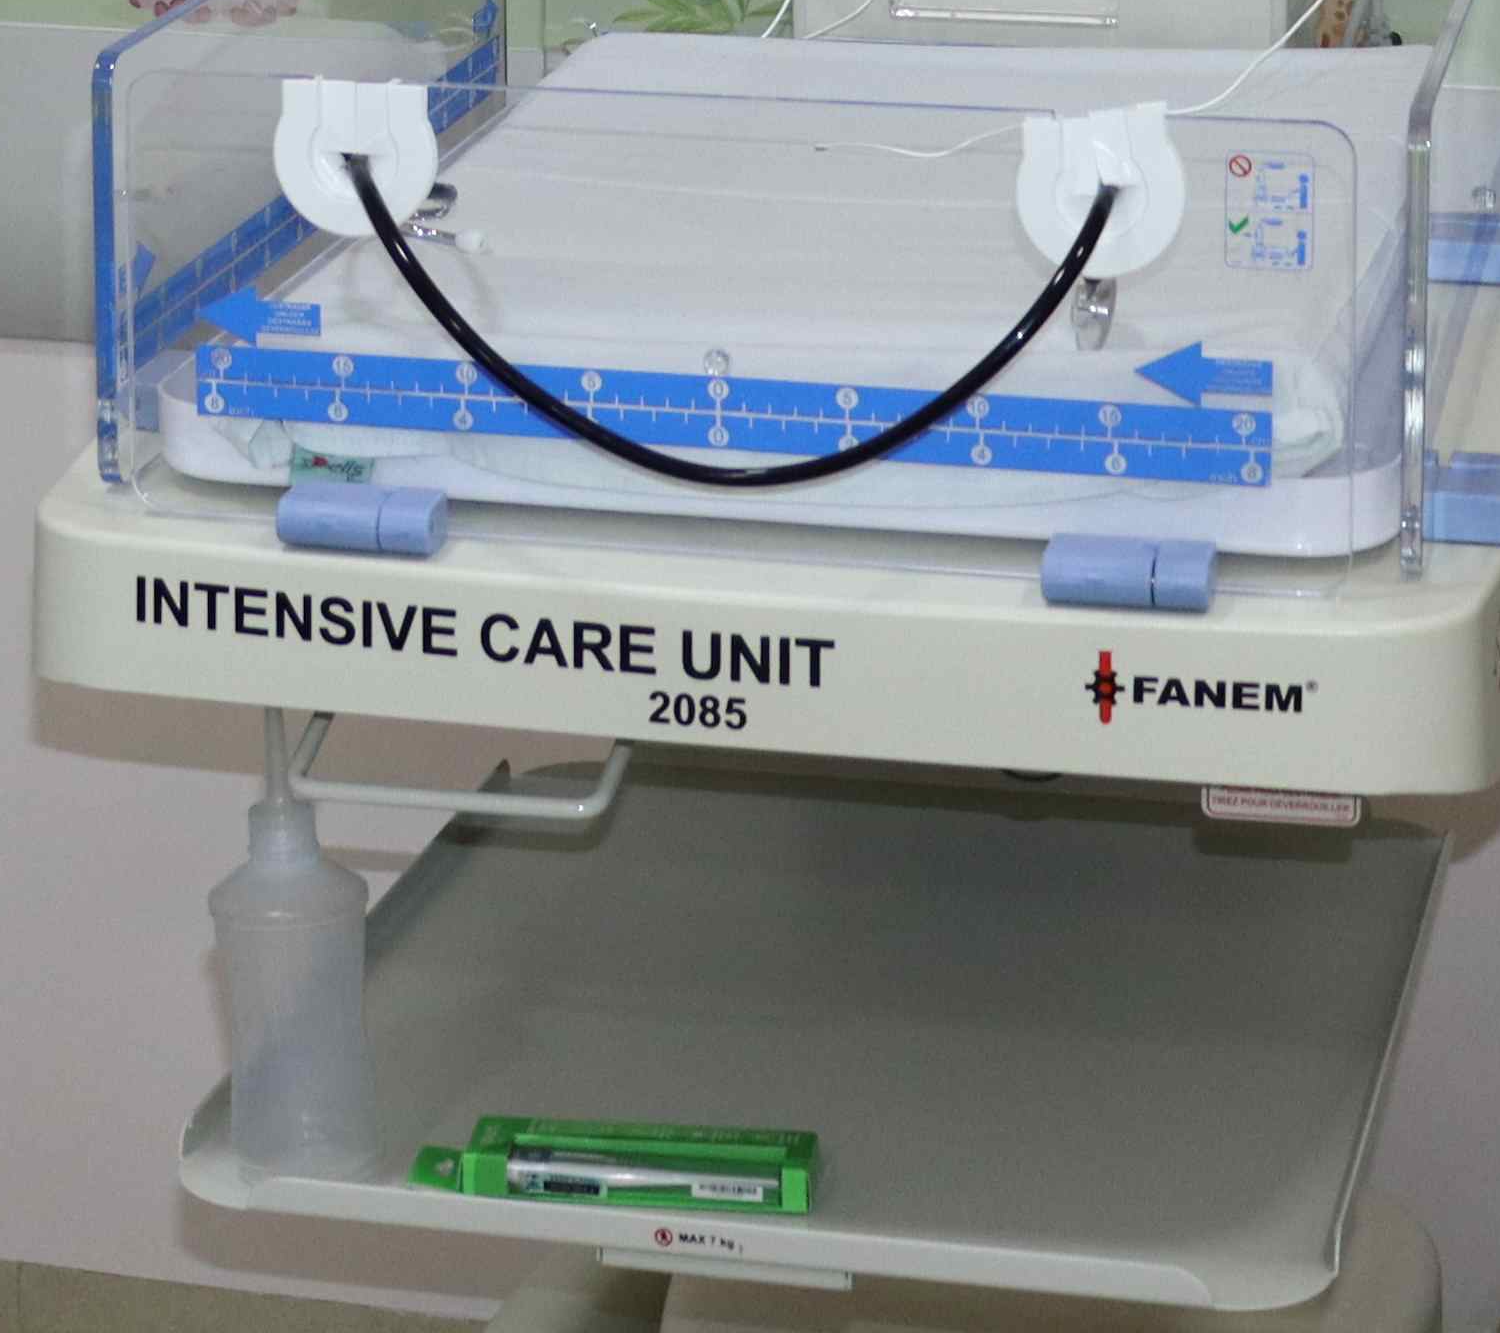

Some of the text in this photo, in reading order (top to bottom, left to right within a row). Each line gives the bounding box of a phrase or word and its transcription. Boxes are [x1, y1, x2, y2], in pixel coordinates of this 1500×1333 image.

[135, 576, 835, 688] INTENSIVE CARE UNIT
[648, 691, 747, 731] 2085
[679, 1234, 705, 1245] MAX
